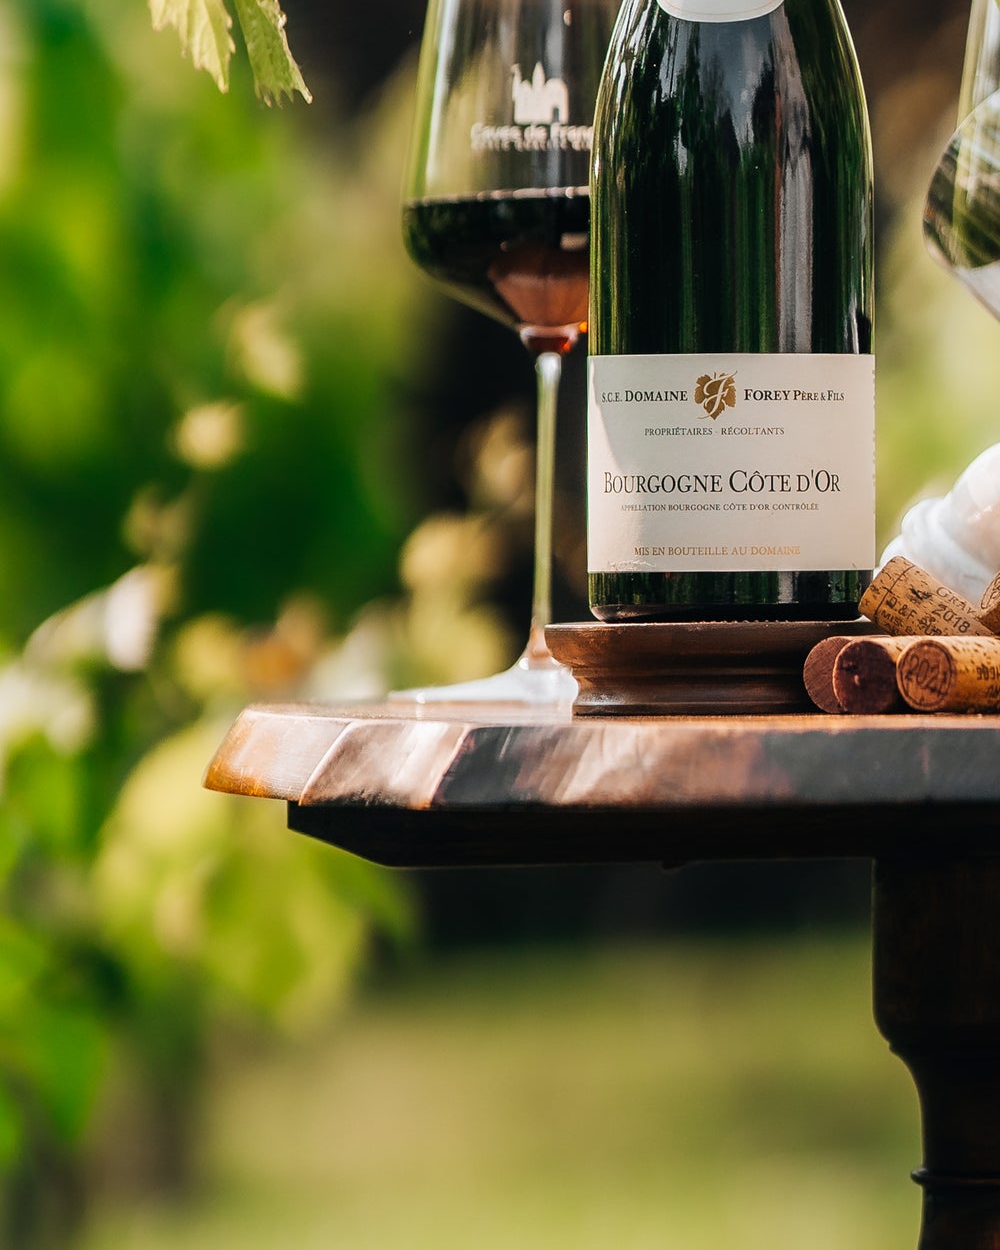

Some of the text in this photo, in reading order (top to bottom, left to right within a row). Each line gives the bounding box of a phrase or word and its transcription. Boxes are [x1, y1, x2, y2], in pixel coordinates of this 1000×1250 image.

[602, 392, 622, 403] S.C.E.
[625, 390, 688, 402] DOMAINE
[744, 389, 791, 401] FOREY
[644, 426, 785, 436] PROPRIÉTAIRES RÉCOLTANTS
[603, 471, 723, 493] BOURGOGNE
[729, 469, 791, 492] CÔTE
[668, 503, 721, 511] BOURGOGNE
[723, 502, 748, 511] CÔTE
[750, 503, 770, 511] D'OR
[772, 502, 820, 511] CONTRÔLÉE
[634, 546, 801, 556] MIS EN BOUTEILLE AU DOMAINE
[931, 603, 970, 633] 2018
